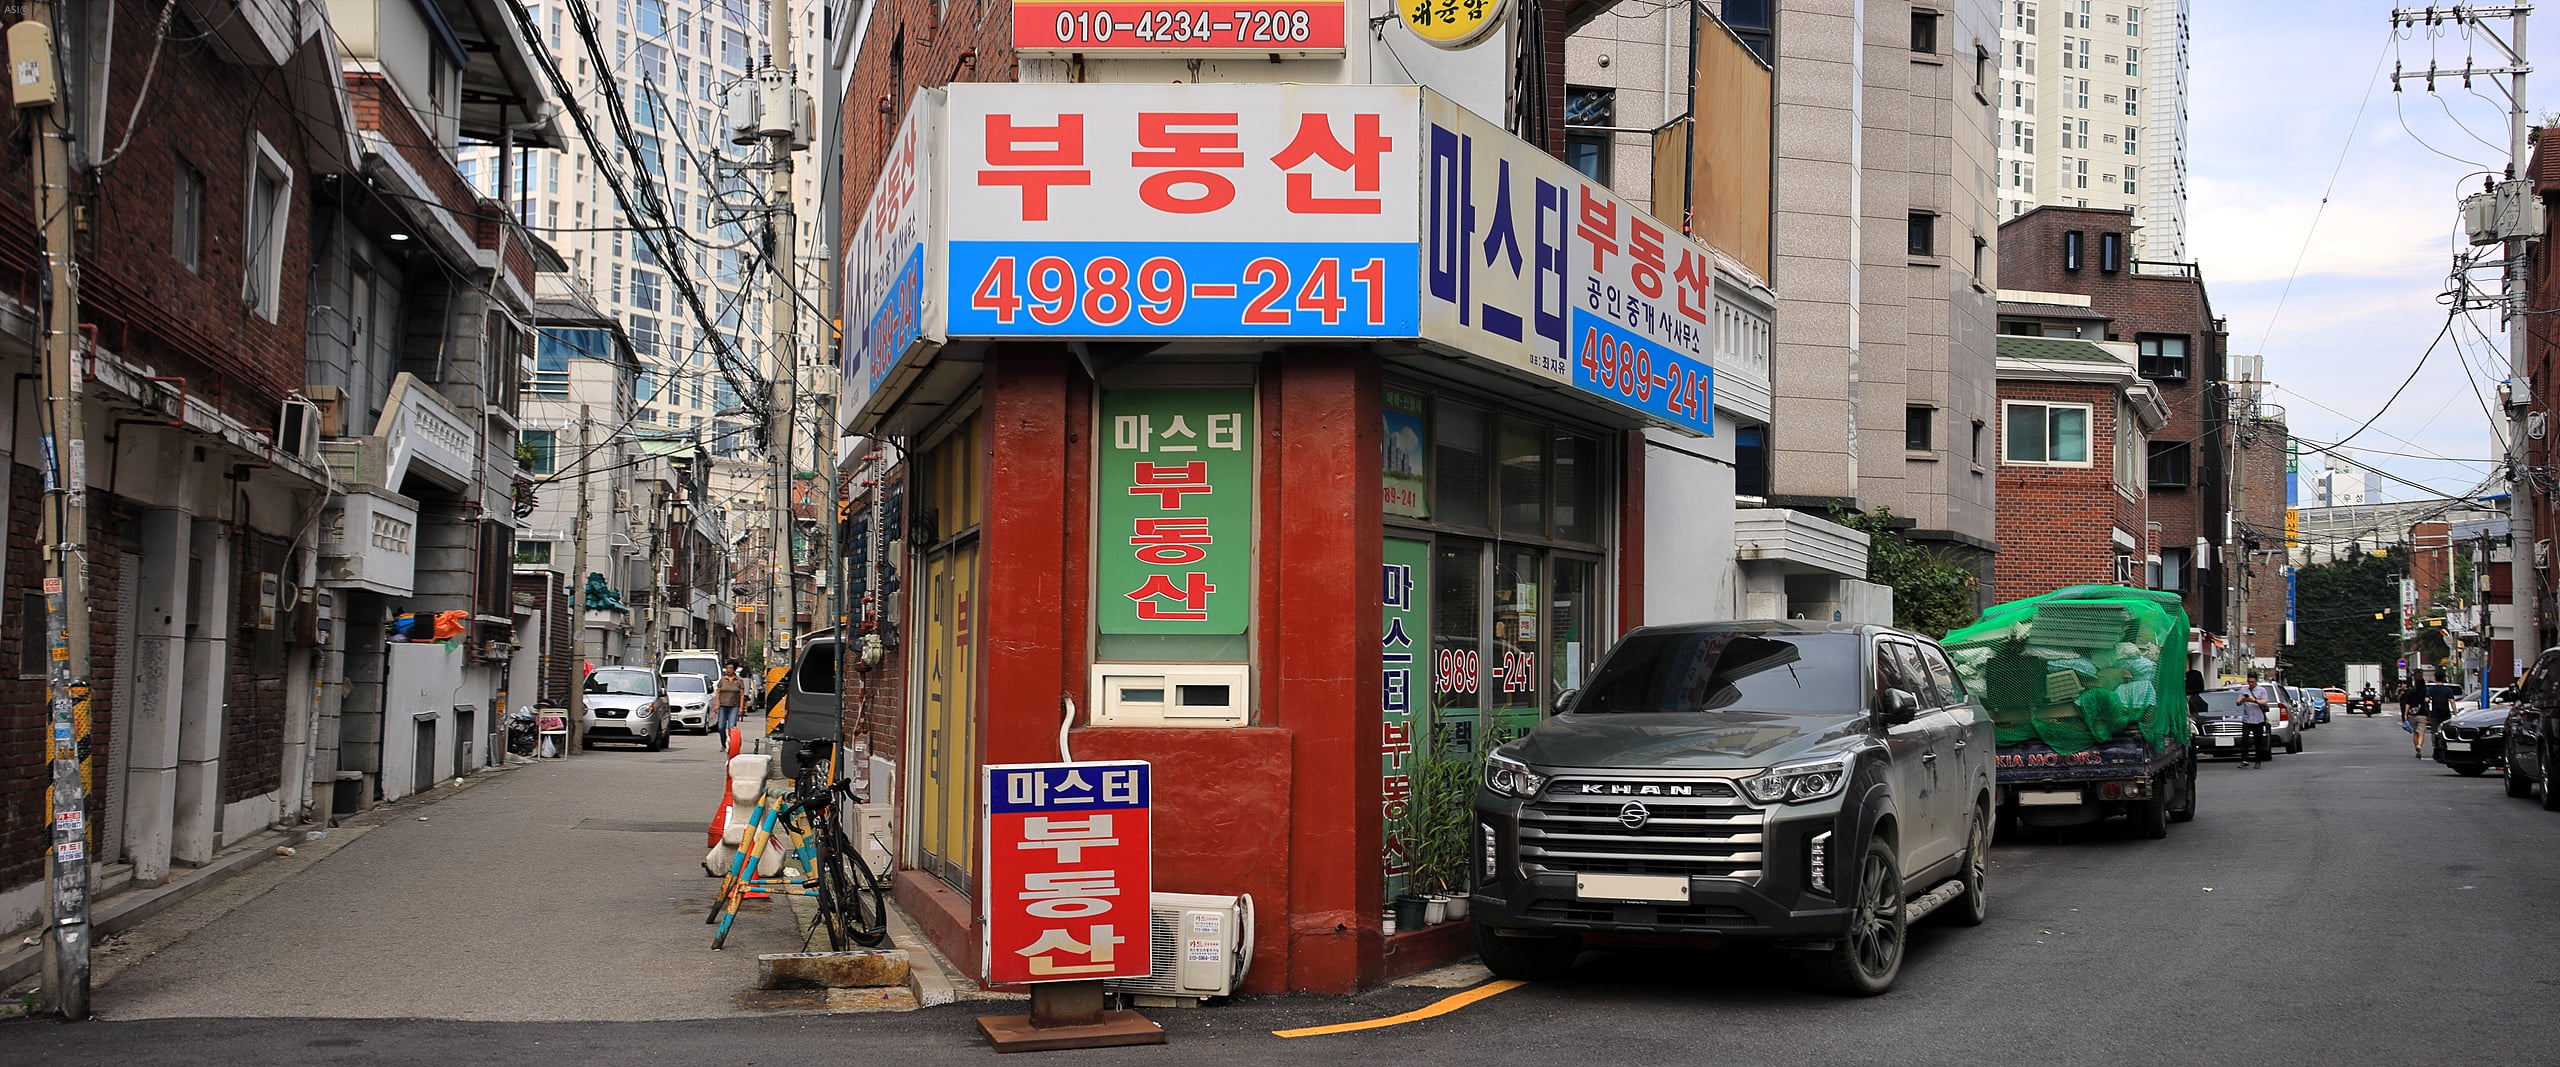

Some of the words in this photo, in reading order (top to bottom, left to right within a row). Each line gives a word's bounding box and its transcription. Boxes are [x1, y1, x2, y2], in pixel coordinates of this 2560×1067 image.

[1055, 10, 1311, 43] 010-4234-7208
[875, 114, 917, 256] 부동산
[977, 112, 1393, 221] 부동산
[844, 210, 872, 387] 마스터
[972, 255, 1386, 325] 4989-241
[1429, 122, 1569, 360] 마스터
[1577, 183, 1710, 326] 부동산
[871, 258, 918, 387] 4989-241
[1581, 327, 1710, 424] 4989-241
[1114, 413, 1242, 452] 마스터
[1124, 461, 1216, 621] 부동산
[956, 591, 969, 672] 부
[1382, 563, 1414, 716] 마스터
[1007, 769, 1139, 807] 마스터
[1382, 721, 1412, 877] 부동산
[1581, 784, 1692, 795] KHAN
[1995, 755, 2024, 767] KIA
[1014, 814, 1126, 976] 부동산
